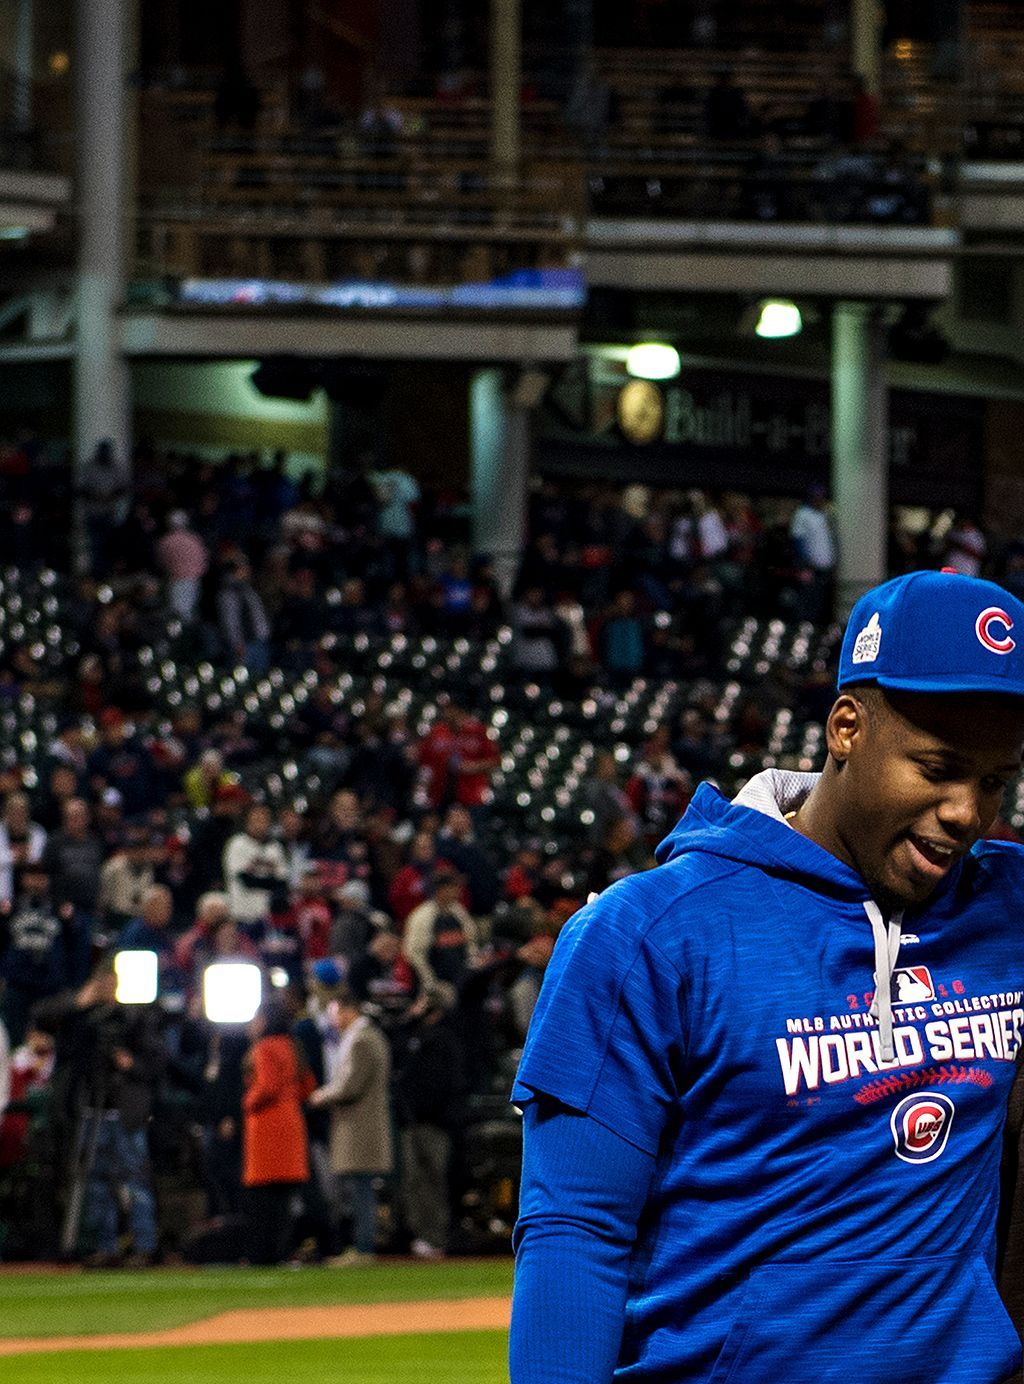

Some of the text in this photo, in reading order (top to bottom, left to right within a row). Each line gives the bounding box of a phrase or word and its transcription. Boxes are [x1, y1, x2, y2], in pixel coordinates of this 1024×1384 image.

[975, 607, 1016, 655] C
[786, 990, 1022, 1034] MLB AUTHTIC COLLECTION
[775, 1008, 1024, 1096] WORLD SERIES
